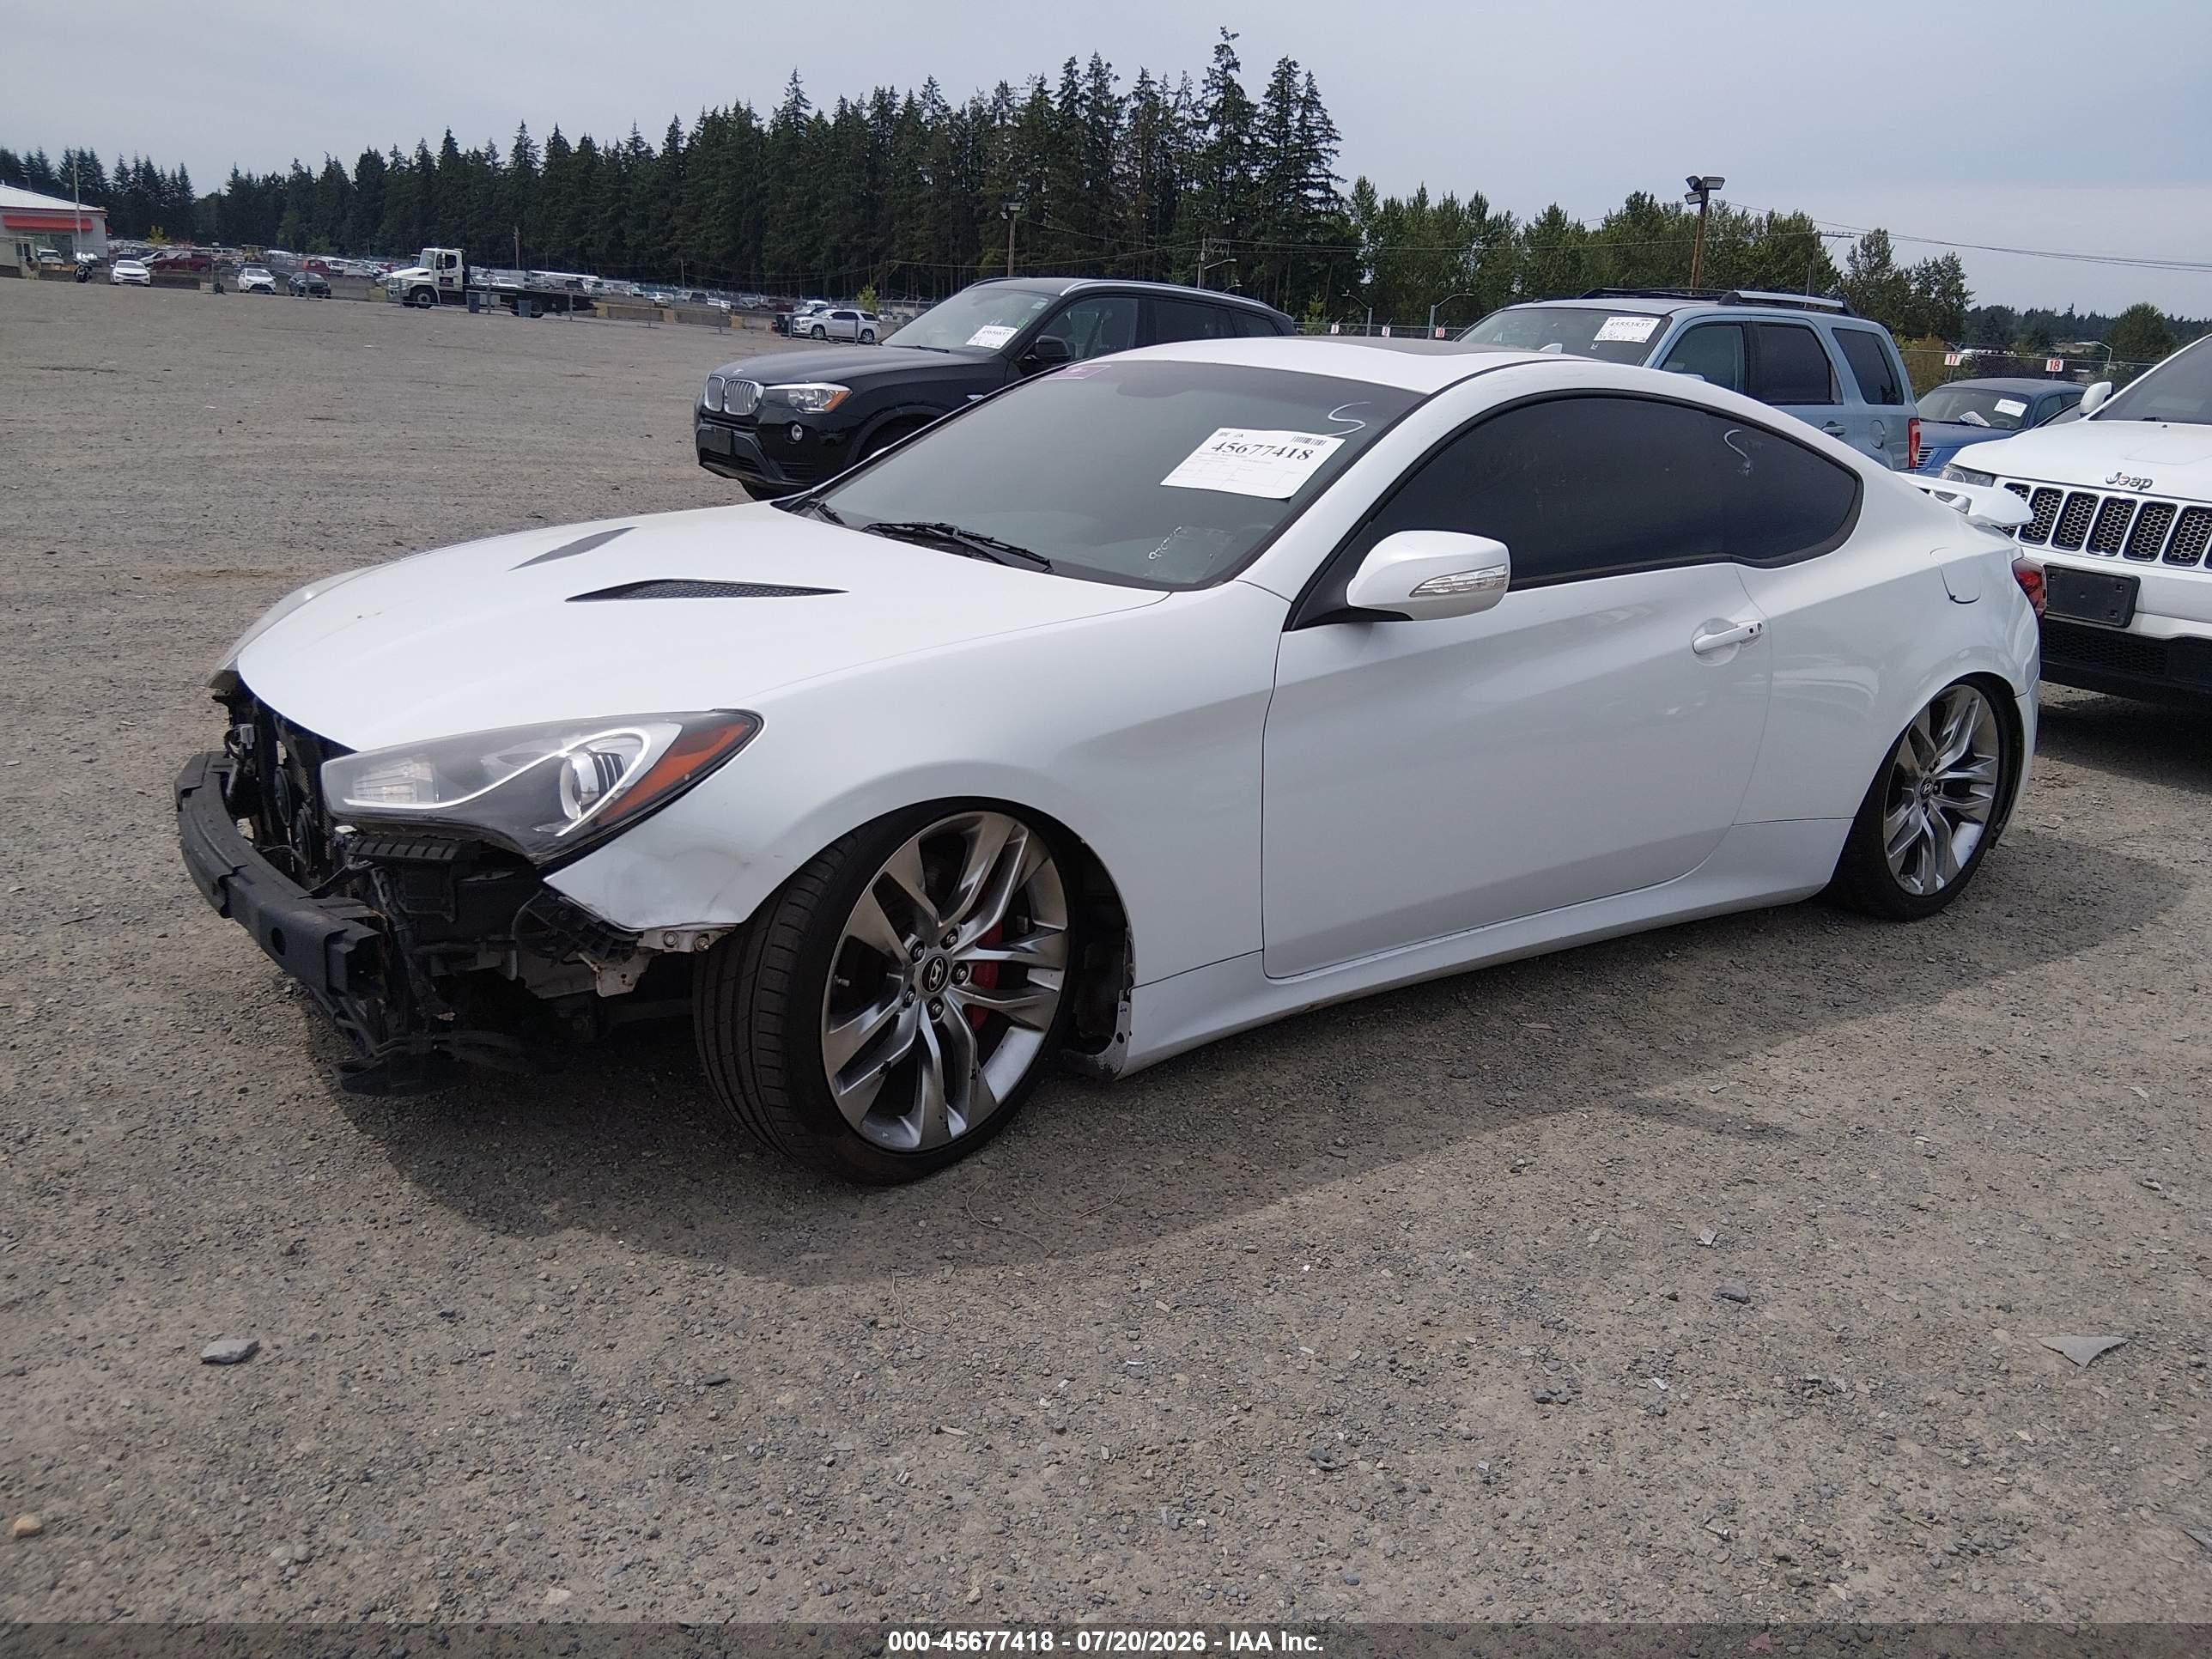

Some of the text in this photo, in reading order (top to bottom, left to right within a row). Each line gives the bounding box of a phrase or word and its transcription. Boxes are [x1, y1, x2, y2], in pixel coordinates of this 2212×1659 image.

[1437, 328, 1444, 337] 10
[1948, 355, 1958, 365] 17
[2049, 360, 2061, 371] 18
[1211, 441, 1315, 461] 45677418
[2106, 471, 2154, 491] Jeep
